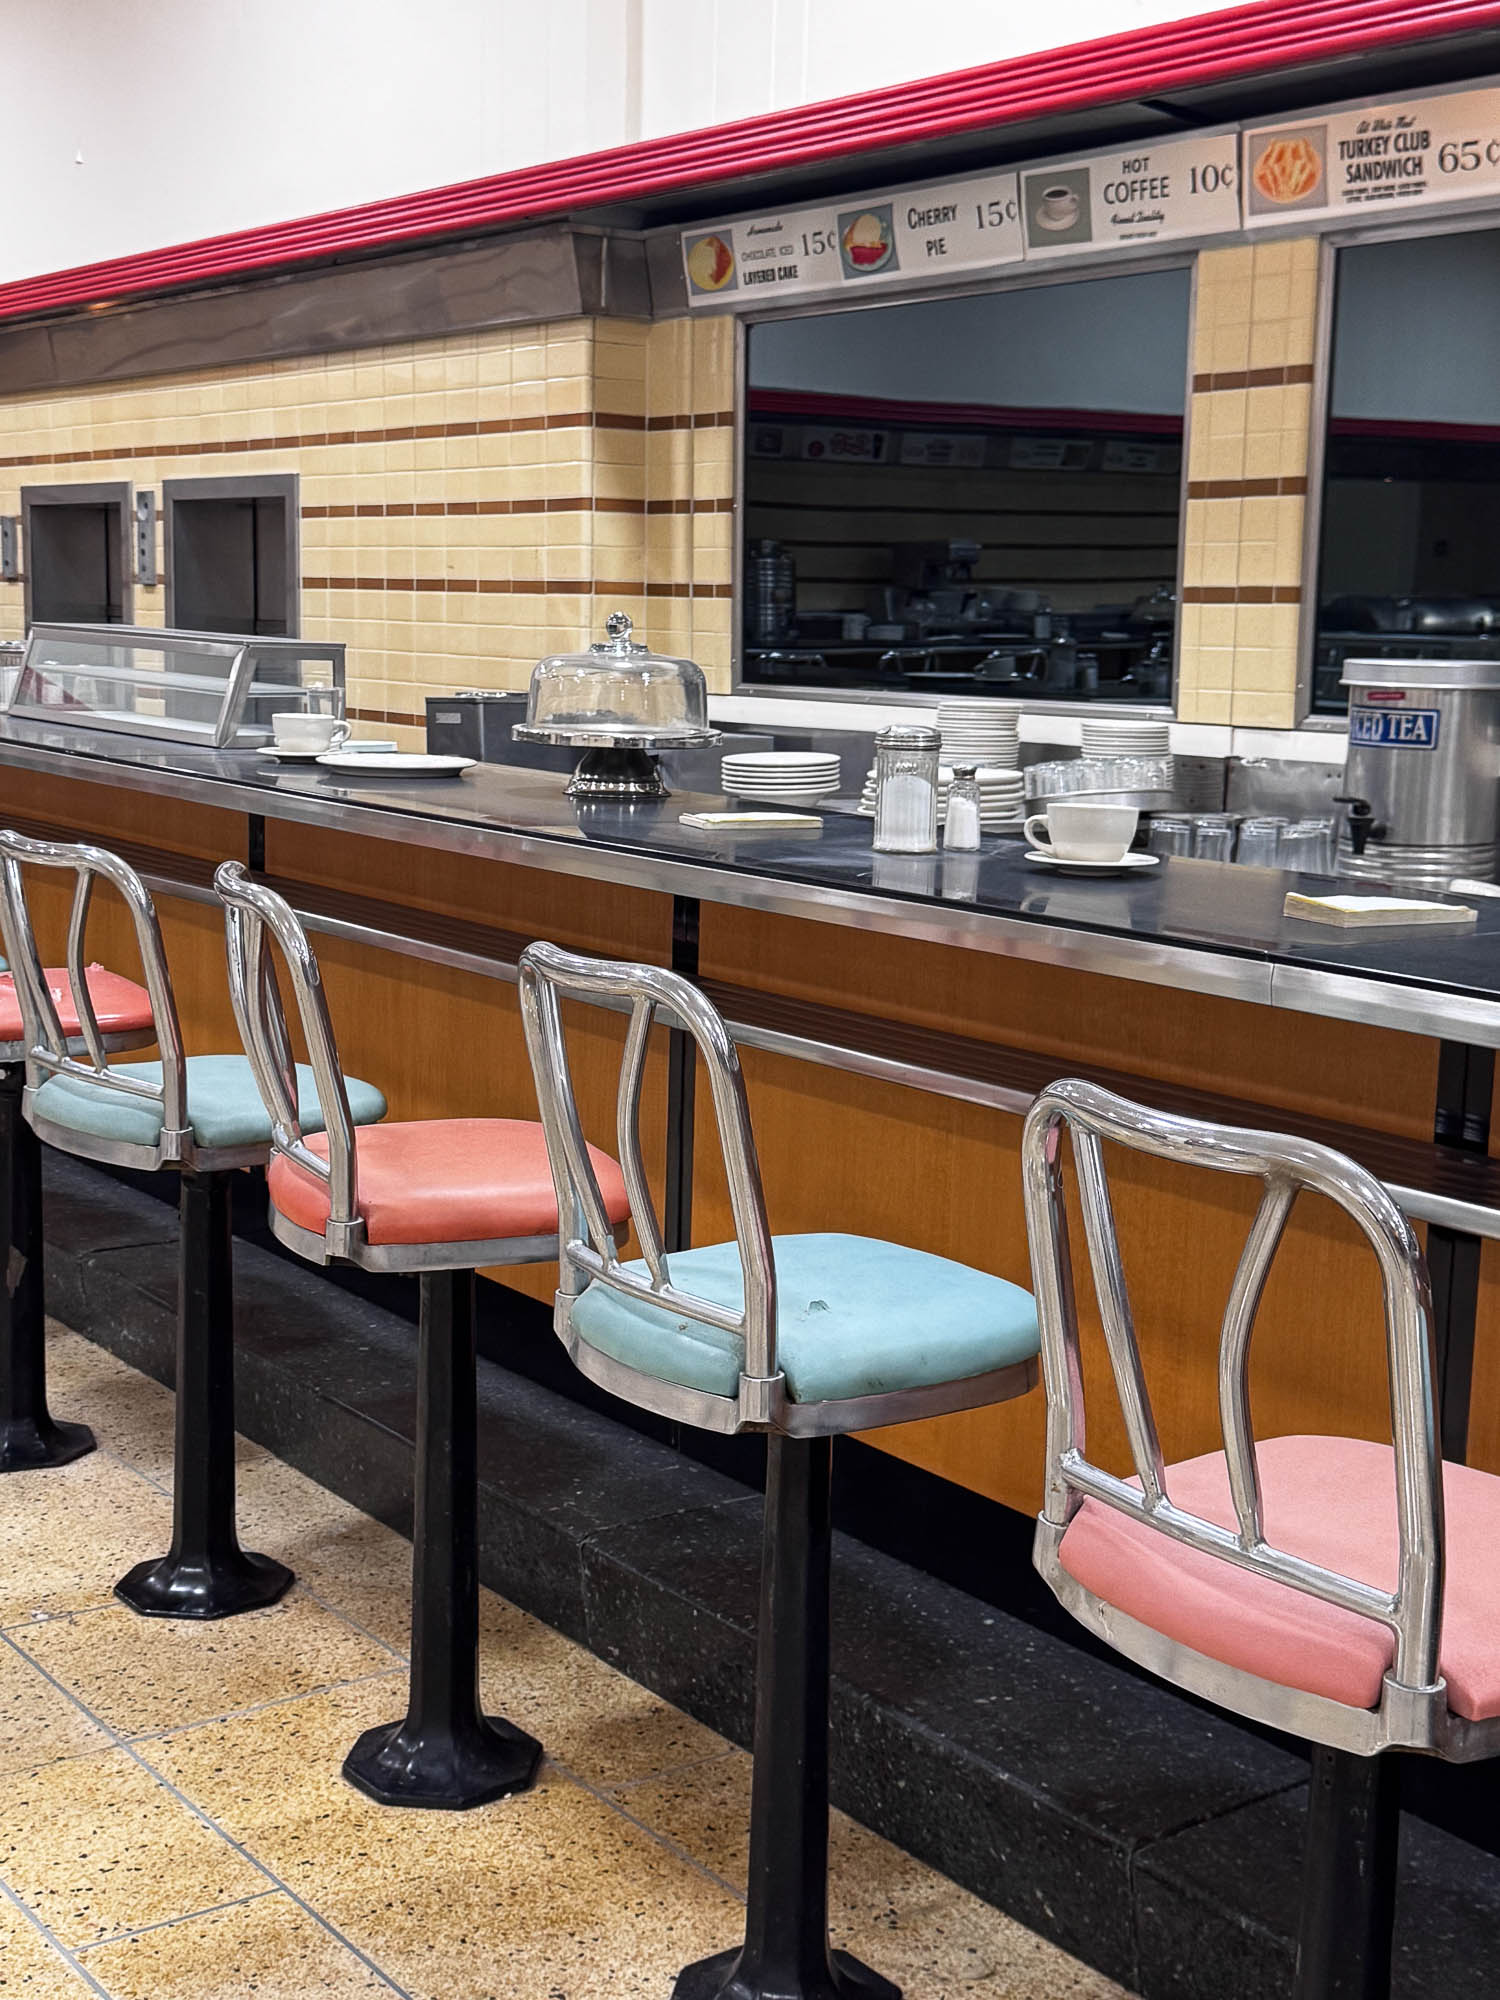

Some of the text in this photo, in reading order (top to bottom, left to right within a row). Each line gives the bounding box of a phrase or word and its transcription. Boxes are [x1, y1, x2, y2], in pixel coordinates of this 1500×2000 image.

[1338, 130, 1430, 160] TURKEY CLUB
[1439, 138, 1500, 174] 65¢
[1122, 157, 1150, 174] HOT
[1346, 156, 1423, 183] SANDWICH
[1104, 176, 1170, 205] COFFEE
[1190, 164, 1234, 195] 10¢
[974, 198, 1018, 231] 15¢
[801, 230, 836, 257] 15¢
[926, 238, 947, 257] PIE
[743, 264, 800, 286] LAYERED CAKE
[1387, 714, 1428, 741] TEA
